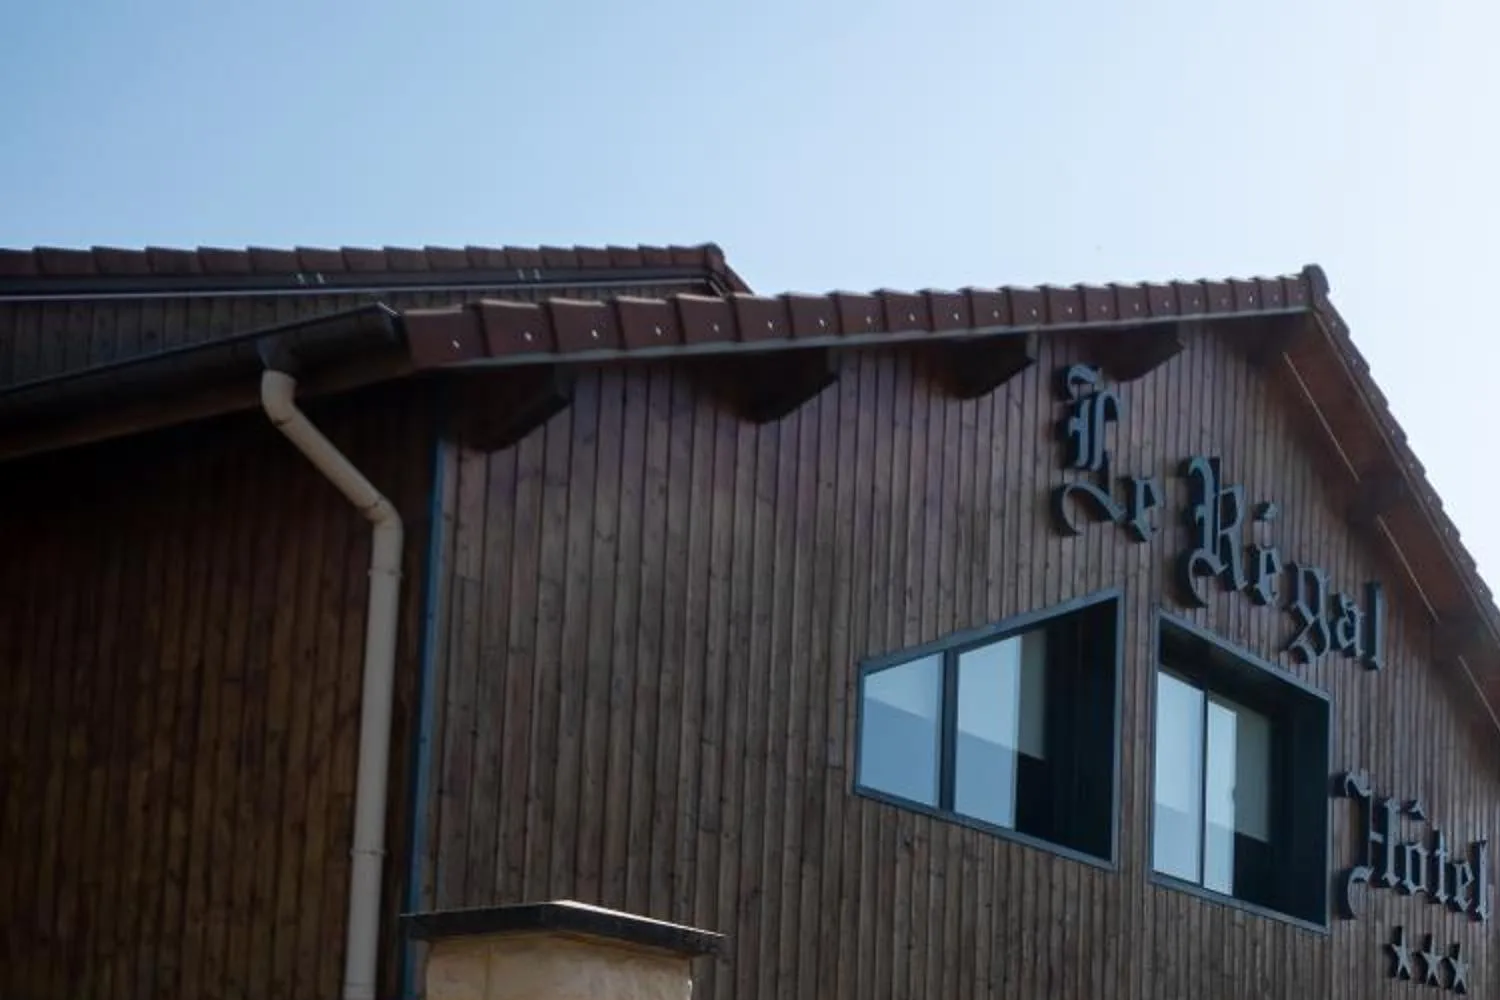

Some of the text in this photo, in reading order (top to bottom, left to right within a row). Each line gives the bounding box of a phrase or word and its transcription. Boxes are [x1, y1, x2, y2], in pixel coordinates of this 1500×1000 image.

[1055, 363, 1385, 671] Le Régal
[1338, 768, 1489, 922] Hôtel
